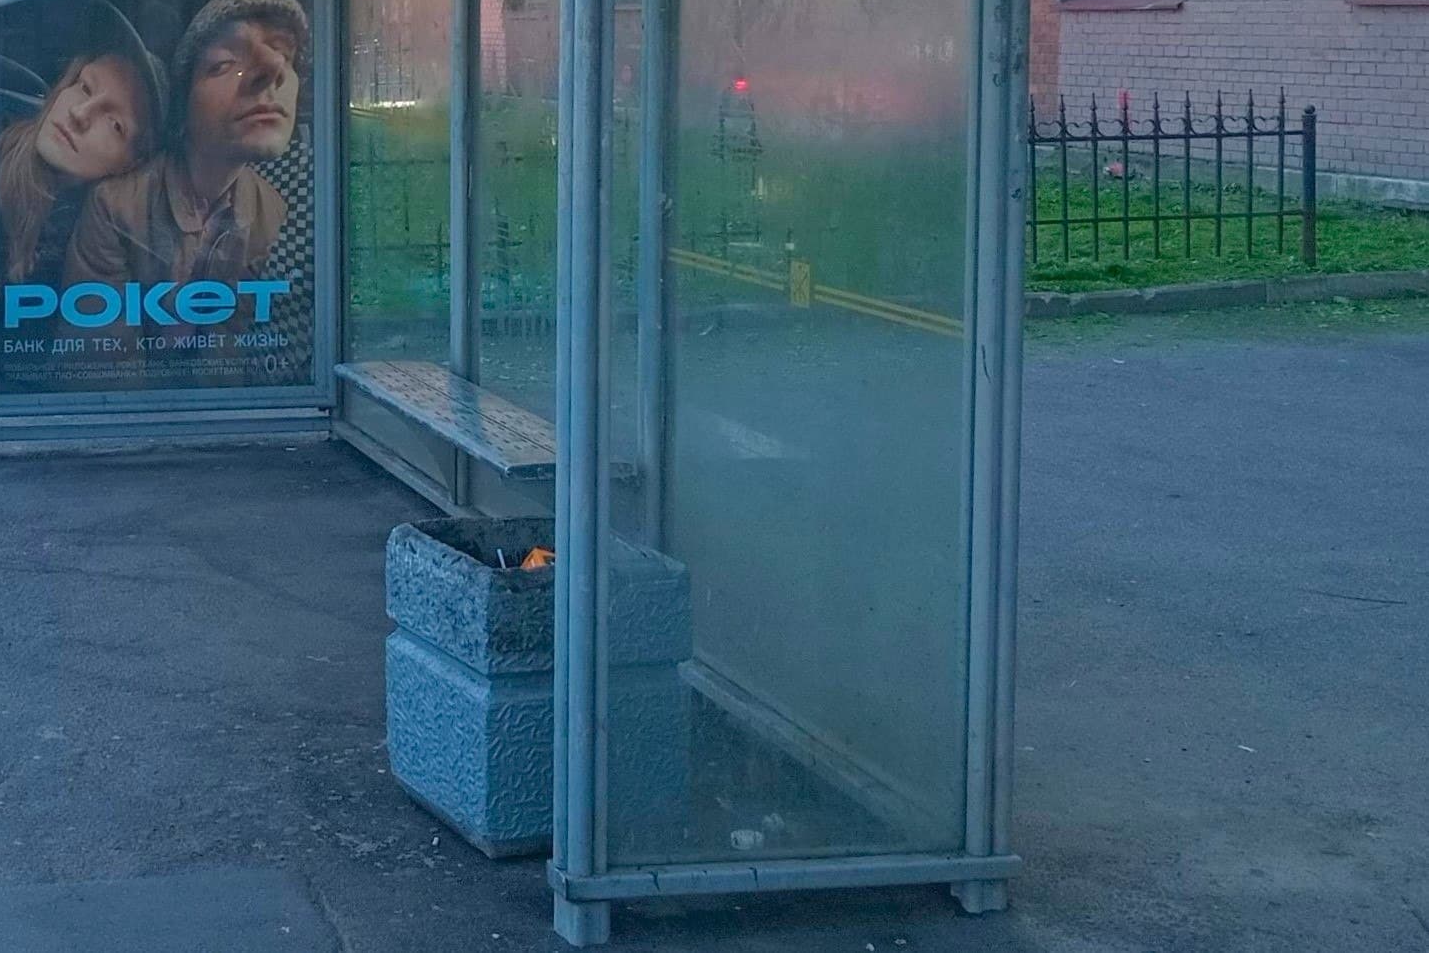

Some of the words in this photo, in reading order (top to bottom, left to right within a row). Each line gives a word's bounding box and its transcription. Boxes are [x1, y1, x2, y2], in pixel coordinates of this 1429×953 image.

[3, 339, 45, 353] БАНК
[52, 338, 85, 354] ДЛЯ
[91, 337, 128, 352] ТЕХ,
[135, 336, 167, 350] КТО
[233, 333, 290, 348] ЖИЗНЬ
